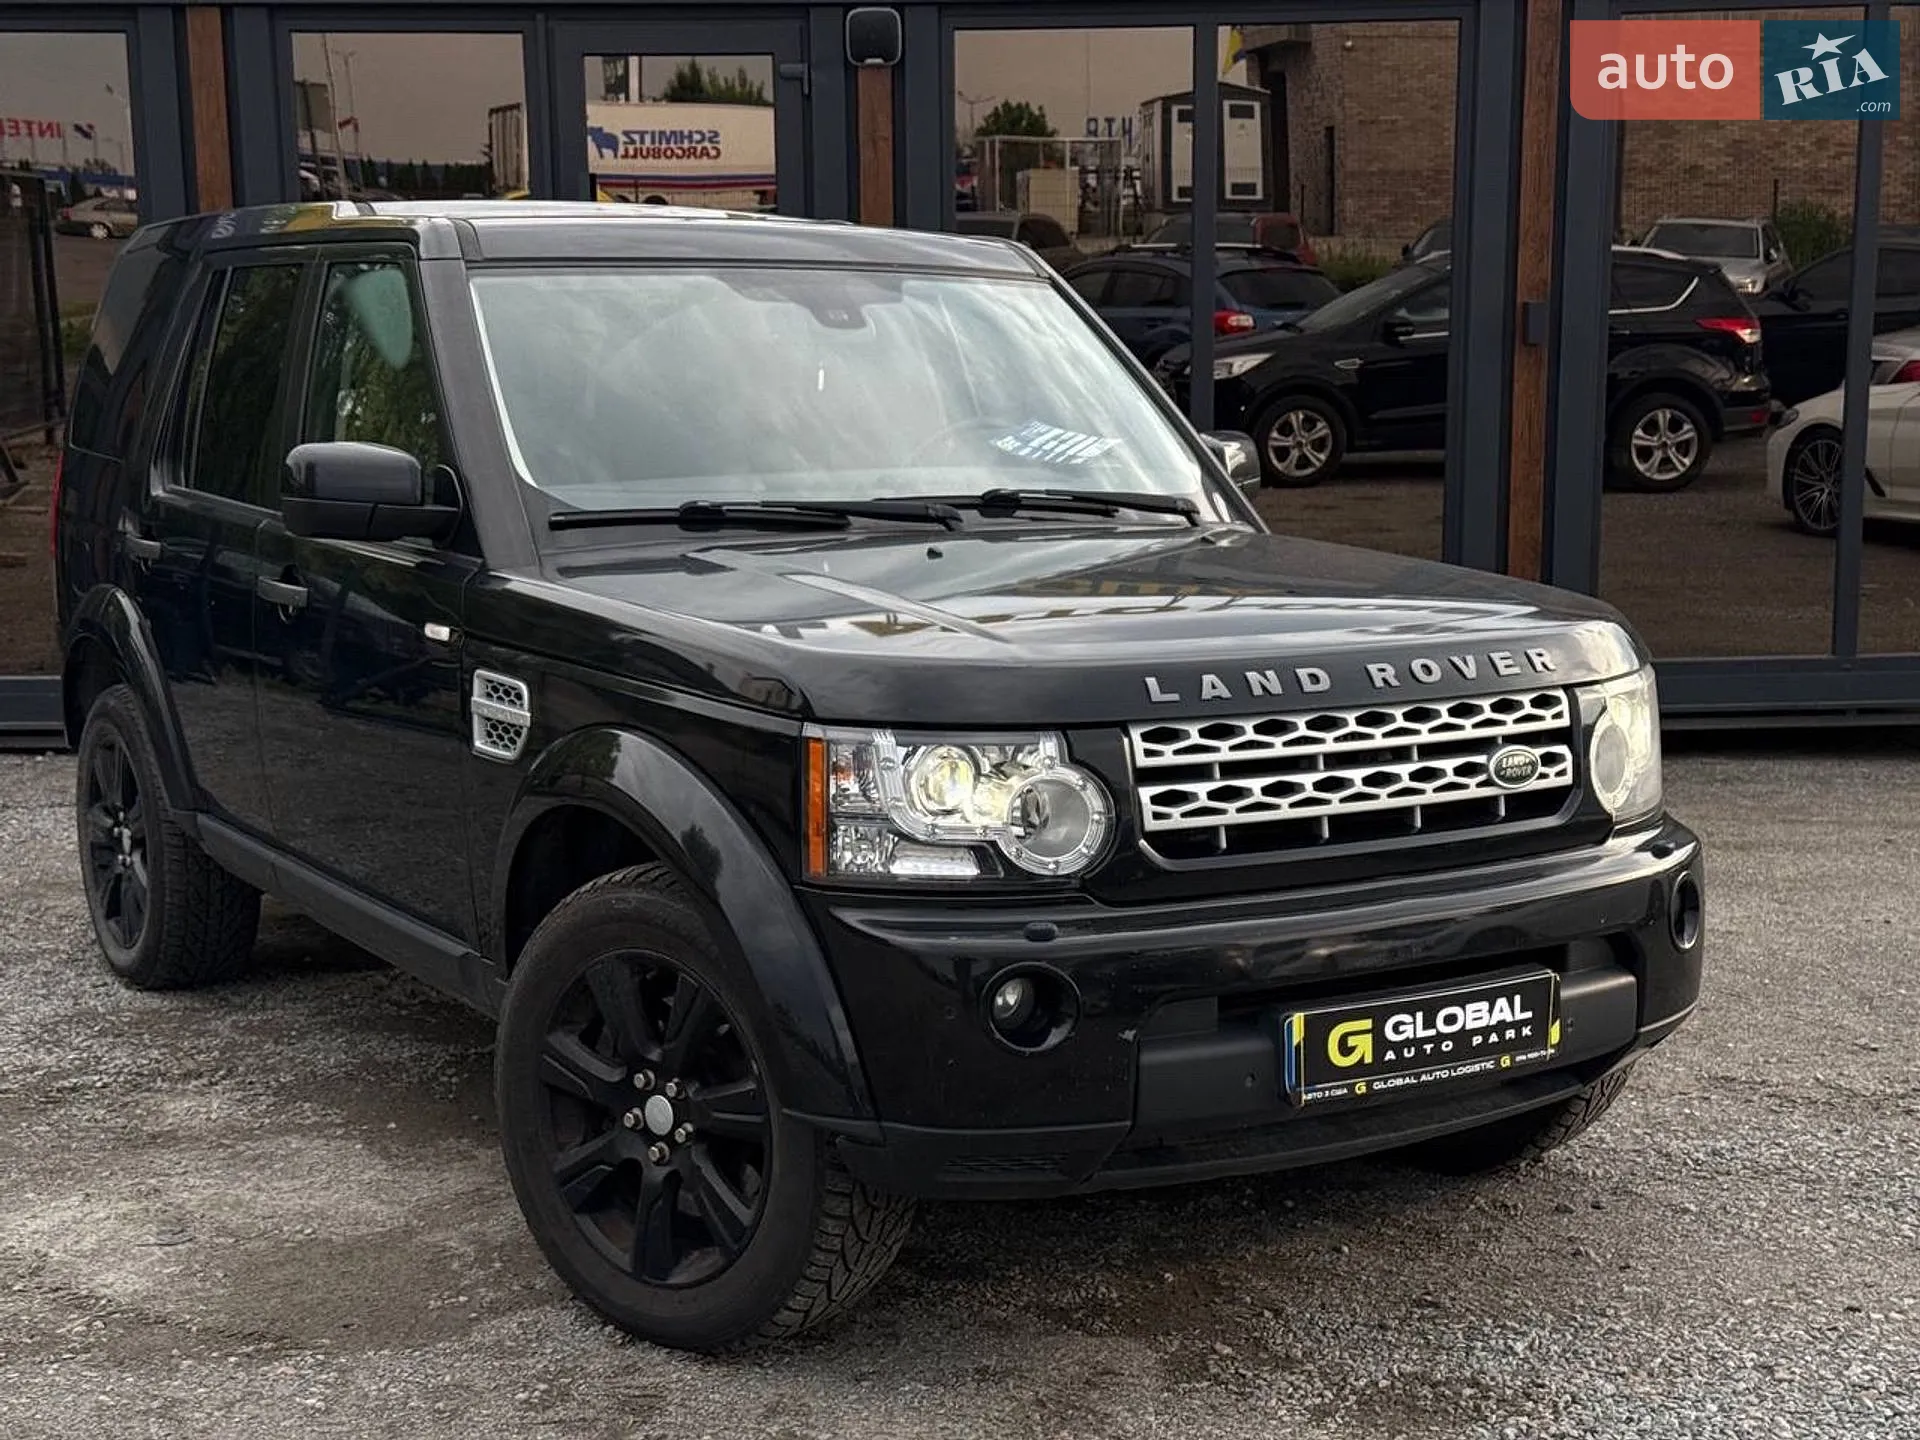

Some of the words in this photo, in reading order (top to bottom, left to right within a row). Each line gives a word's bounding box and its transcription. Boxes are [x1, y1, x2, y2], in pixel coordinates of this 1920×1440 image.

[1145, 667, 1331, 703] LAND
[1366, 647, 1558, 689] ROVER
[1384, 994, 1533, 1042] GLOBAL
[1384, 1041, 1453, 1061] AUTO
[1472, 1025, 1533, 1047] PARK
[1372, 1076, 1418, 1091] GLOBAL
[1420, 1069, 1449, 1082] AUTO
[1450, 1060, 1496, 1077] LOGISTIC
